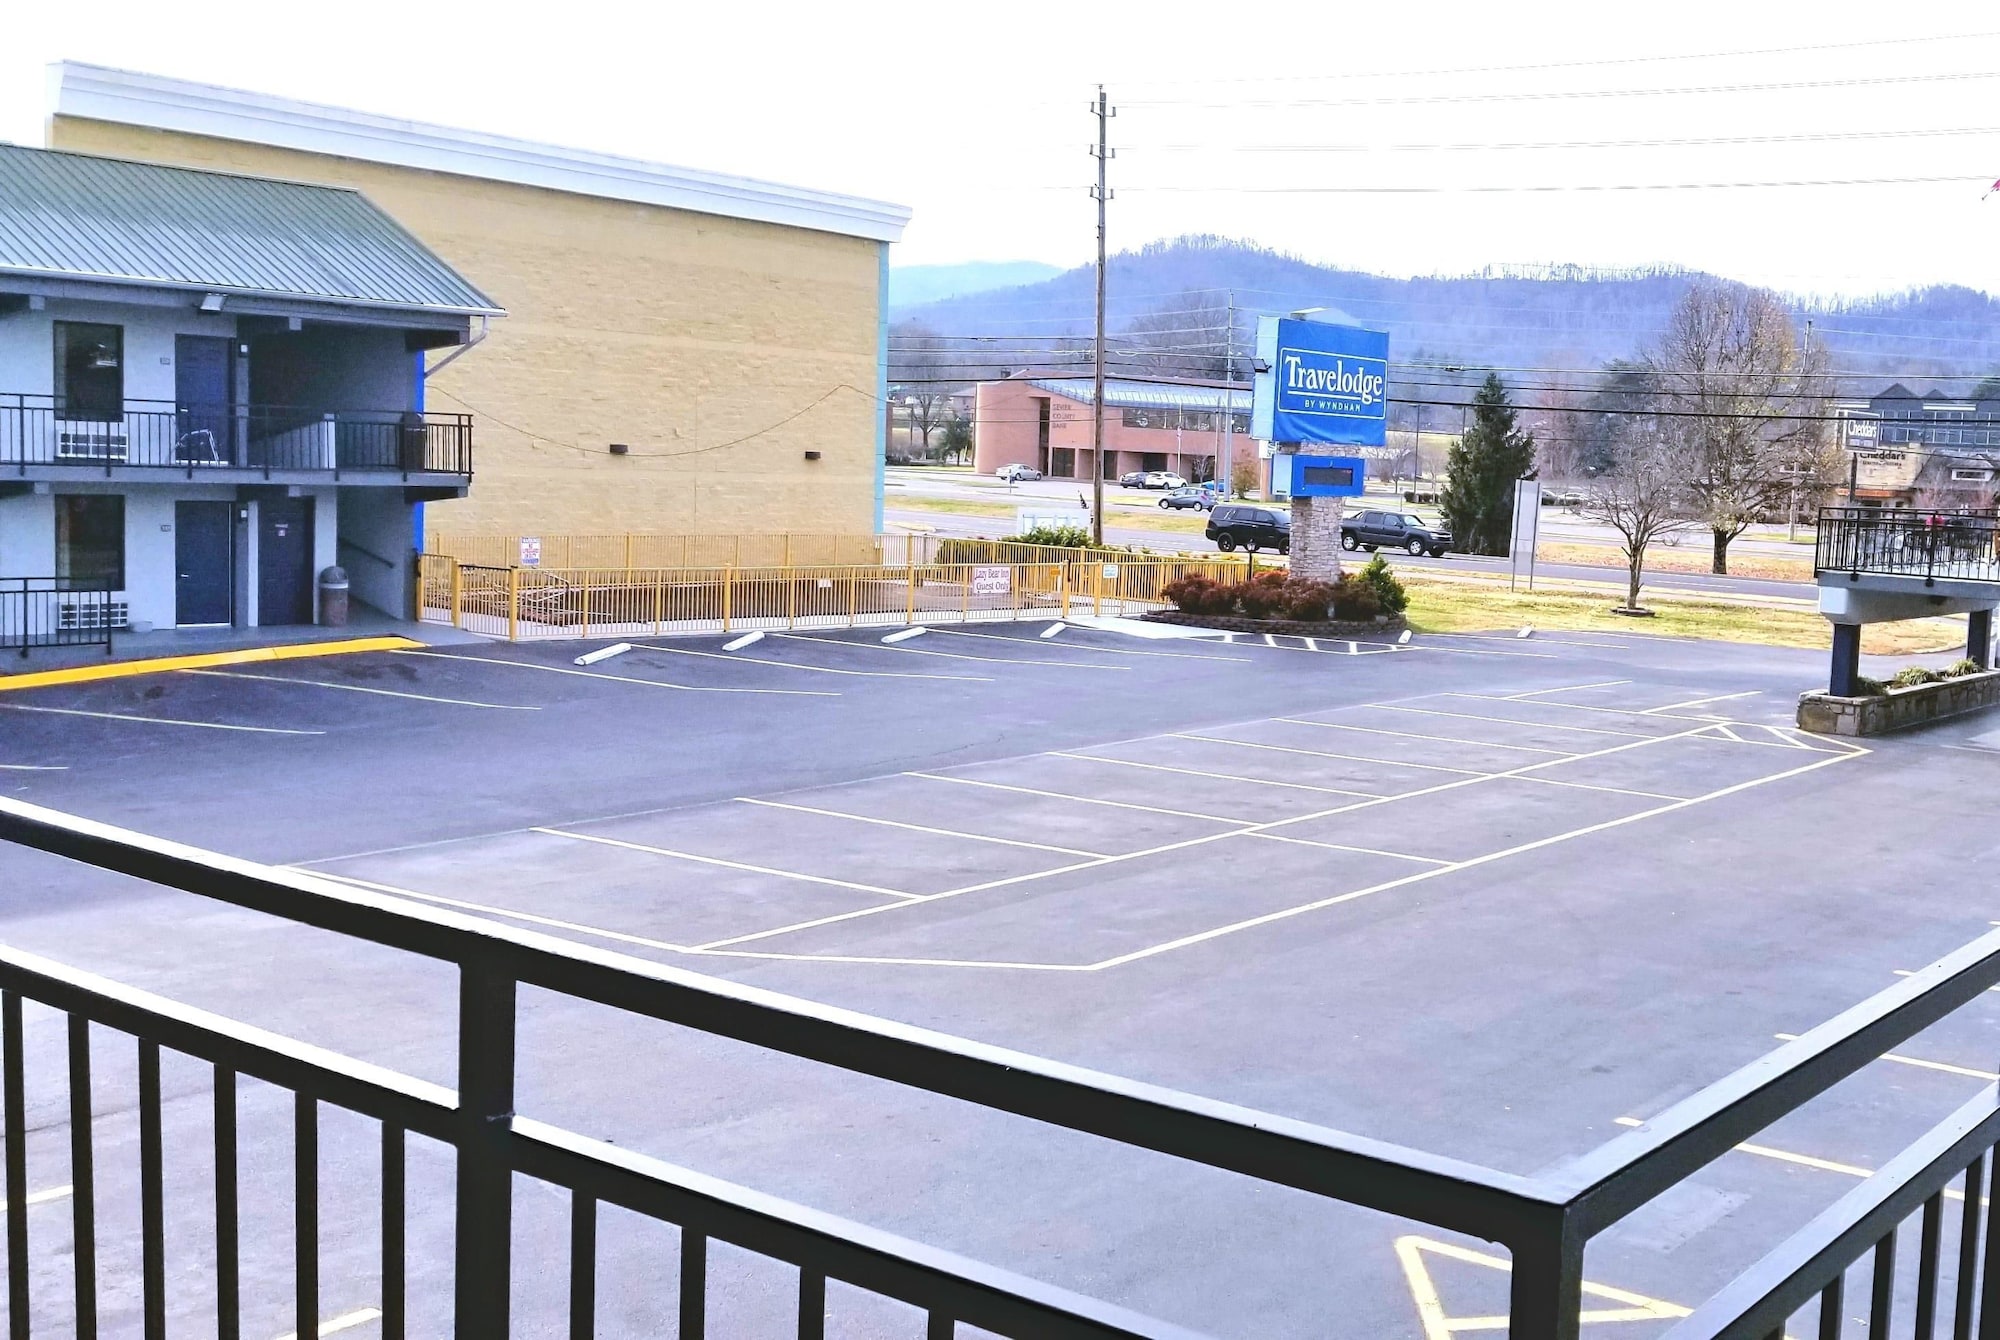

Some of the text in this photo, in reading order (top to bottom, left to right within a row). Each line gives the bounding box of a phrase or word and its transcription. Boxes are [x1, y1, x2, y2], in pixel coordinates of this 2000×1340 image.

[1285, 355, 1383, 405] Travelodge
[1305, 399, 1361, 412] BY WYNDHAM
[974, 569, 1010, 581] Lazy Bear Inn
[976, 581, 1009, 591] Guest Only
